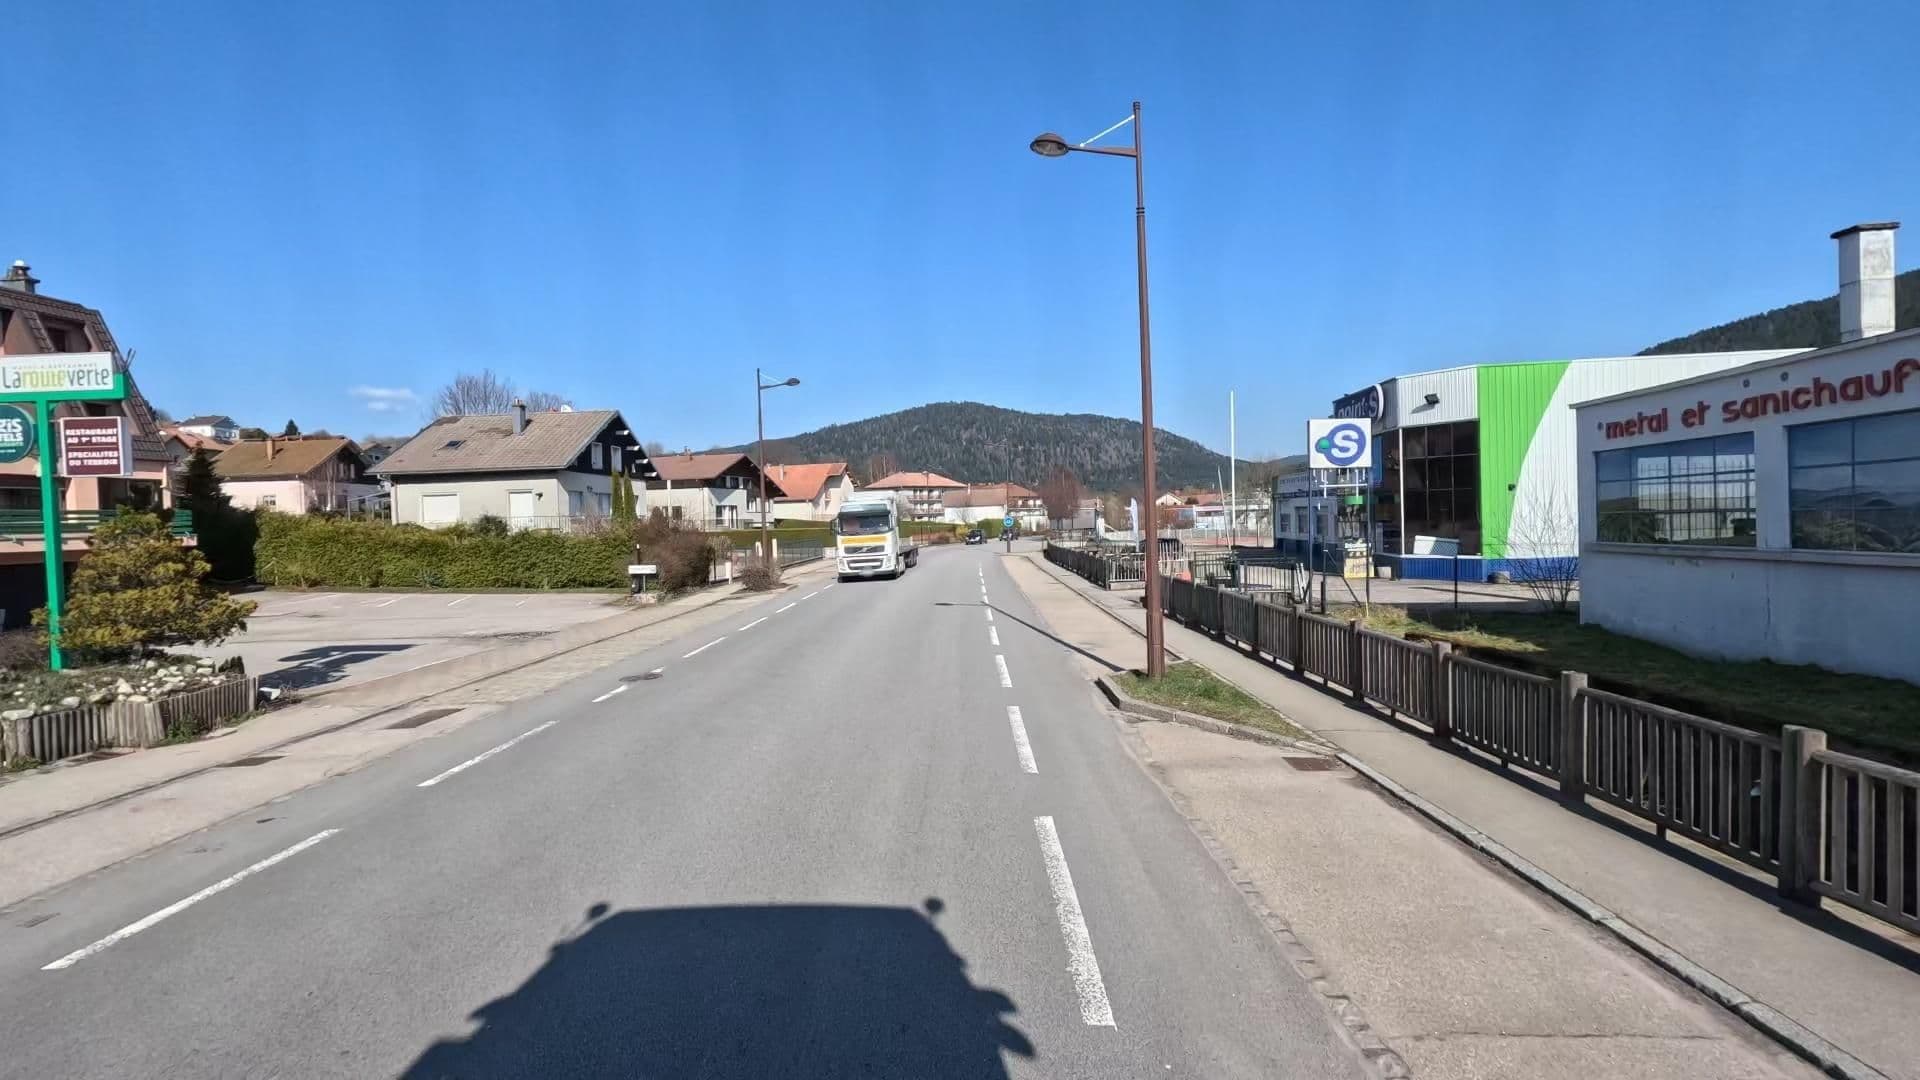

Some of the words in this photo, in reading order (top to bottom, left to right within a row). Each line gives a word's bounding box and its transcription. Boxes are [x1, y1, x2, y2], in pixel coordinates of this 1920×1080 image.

[1606, 407, 1669, 440] metal
[1681, 401, 1711, 428] et
[67, 451, 118, 459] SPECIALITES
[1331, 429, 1358, 458] S
